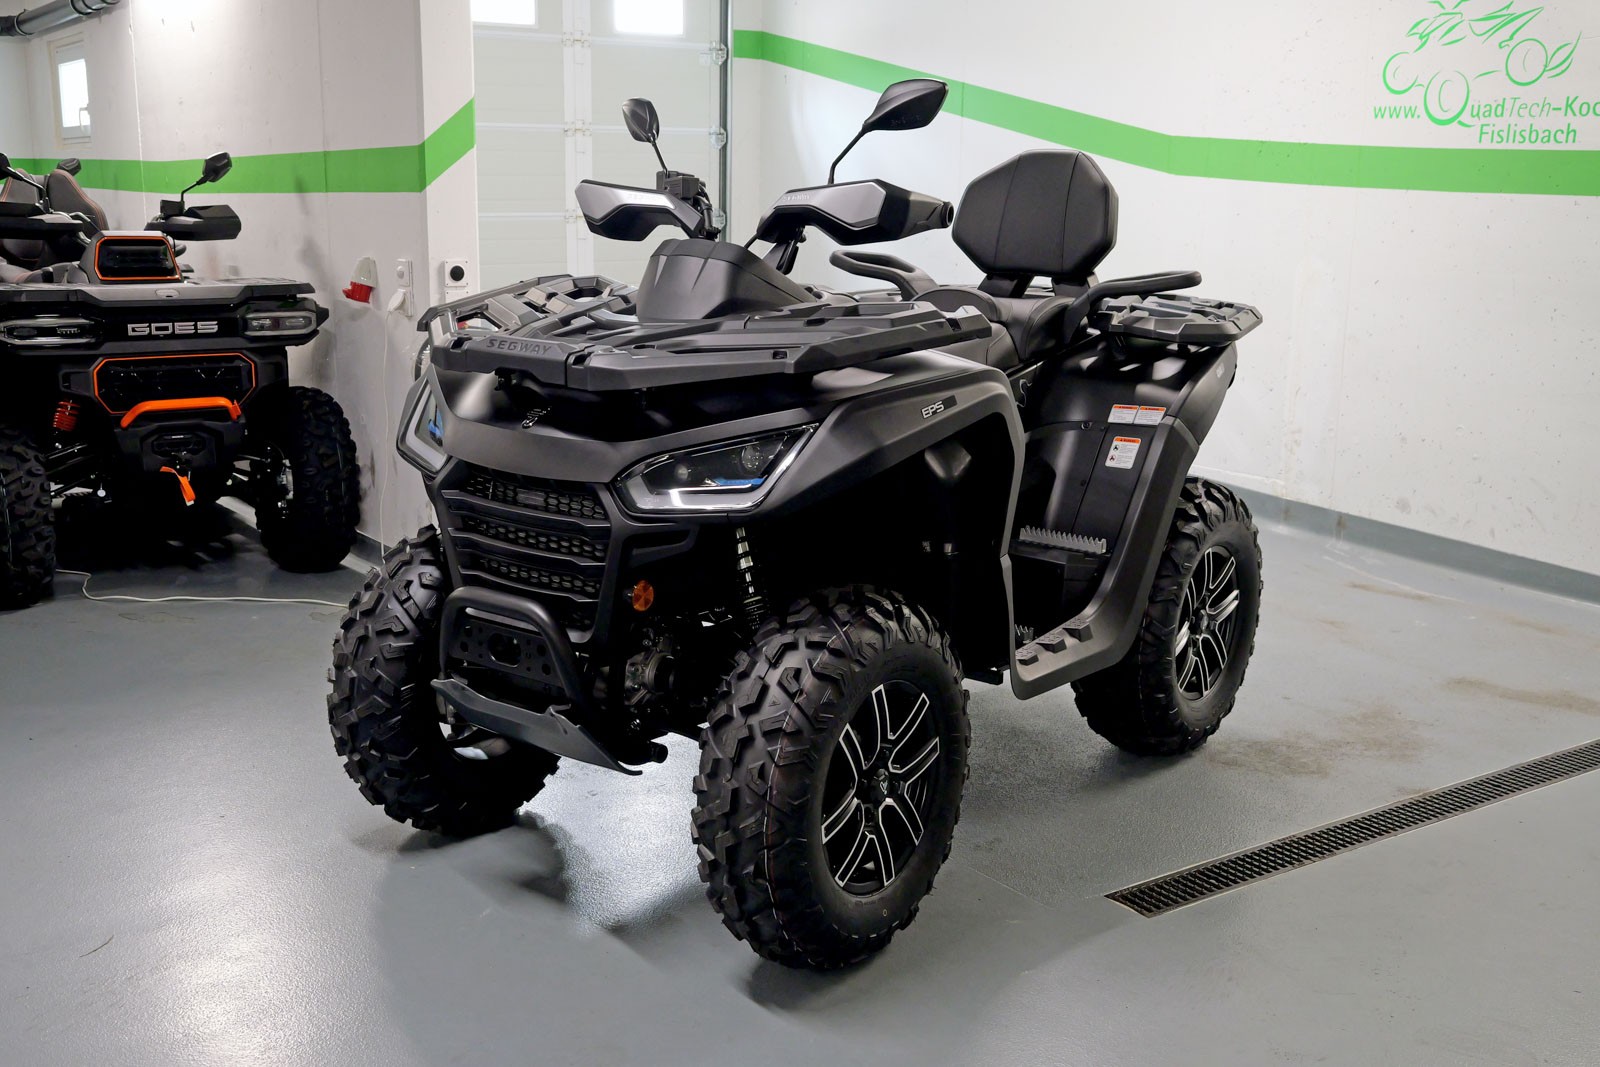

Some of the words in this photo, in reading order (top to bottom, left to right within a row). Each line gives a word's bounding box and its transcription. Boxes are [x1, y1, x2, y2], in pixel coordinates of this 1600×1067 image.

[1478, 123, 1577, 144] Fislisbach
[127, 320, 219, 336] GOES
[486, 338, 552, 356] SEGWAY
[921, 400, 945, 419] EPS
